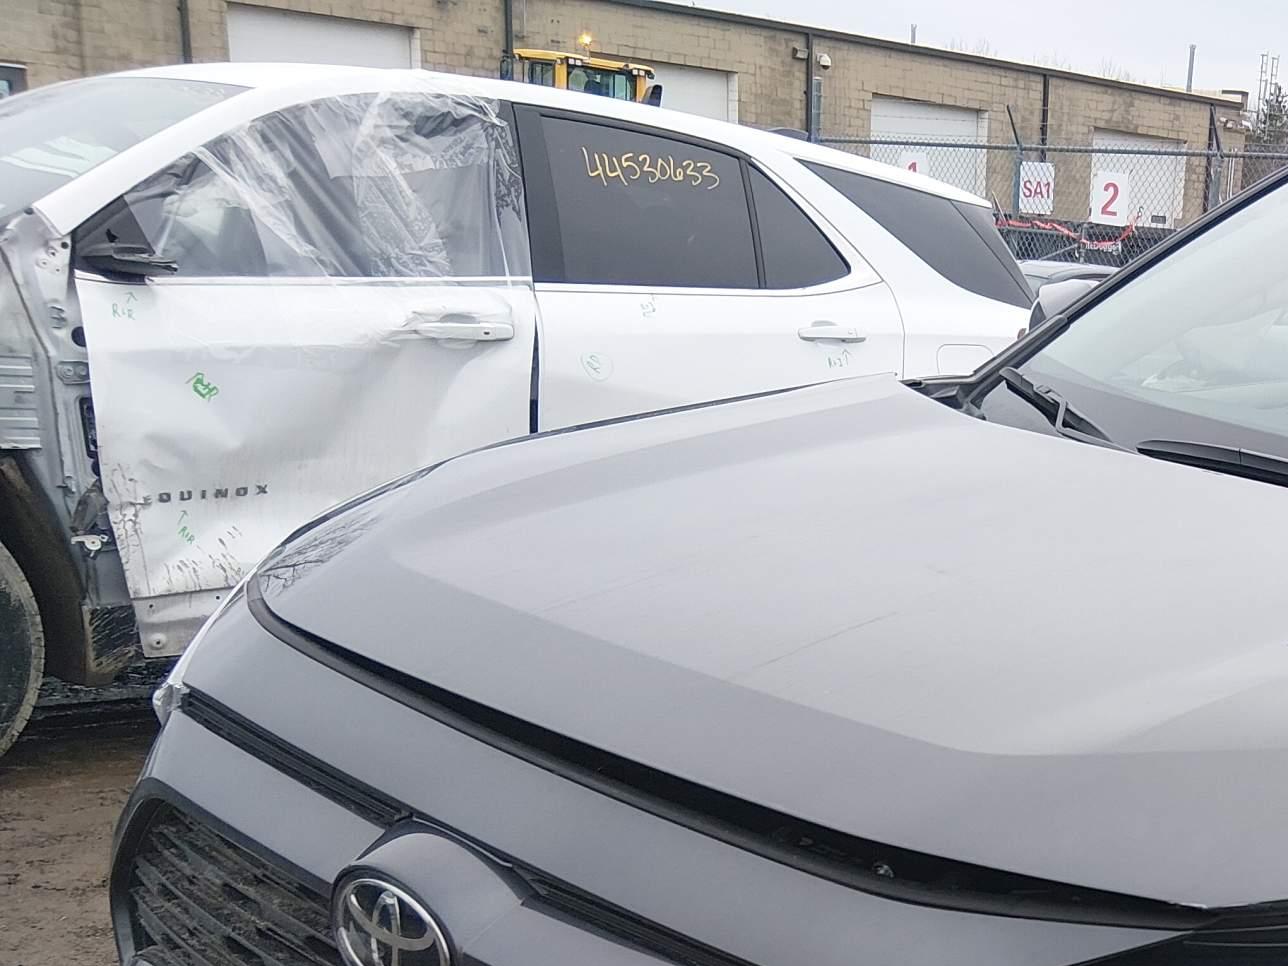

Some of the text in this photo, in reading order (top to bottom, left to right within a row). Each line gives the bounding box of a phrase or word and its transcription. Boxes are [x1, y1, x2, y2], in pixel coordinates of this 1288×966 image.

[581, 147, 720, 190] 44530633
[1023, 180, 1051, 199] SA1
[1101, 182, 1120, 216] 2
[142, 484, 269, 509] EQUINOX
